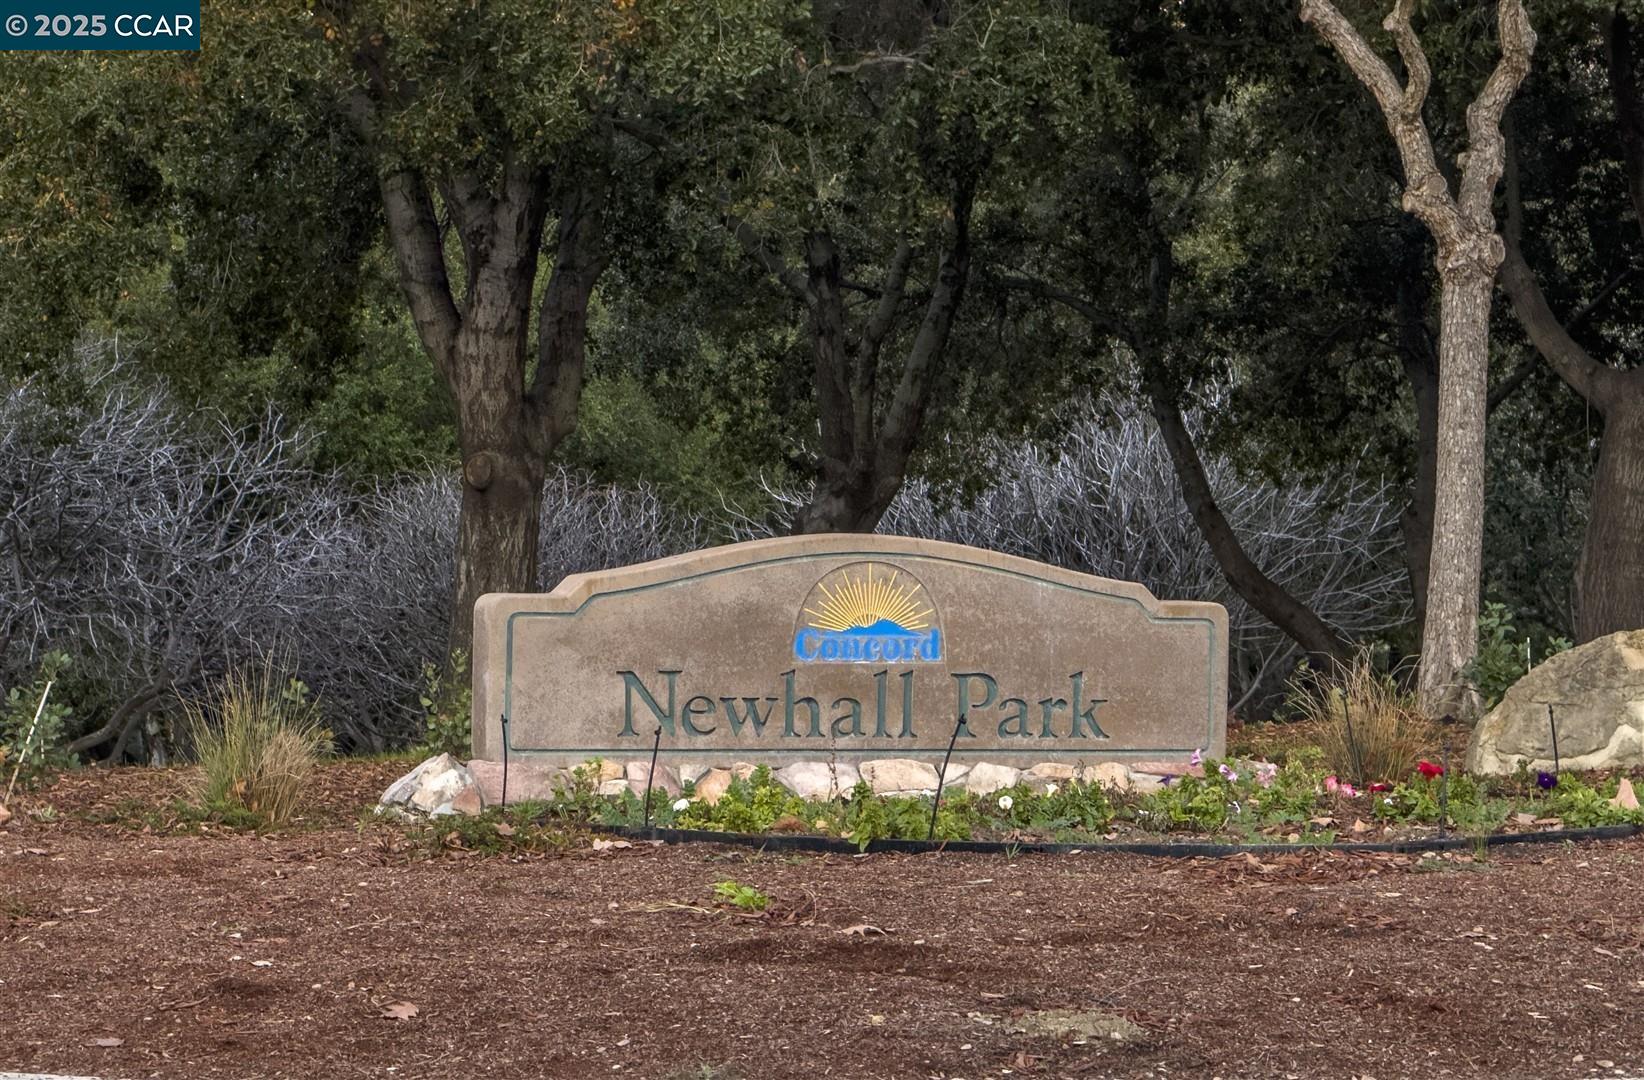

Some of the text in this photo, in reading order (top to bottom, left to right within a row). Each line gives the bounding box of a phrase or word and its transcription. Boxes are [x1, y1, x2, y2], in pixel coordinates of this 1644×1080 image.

[794, 627, 942, 662] Concord
[616, 669, 1110, 739] Newhall Park
